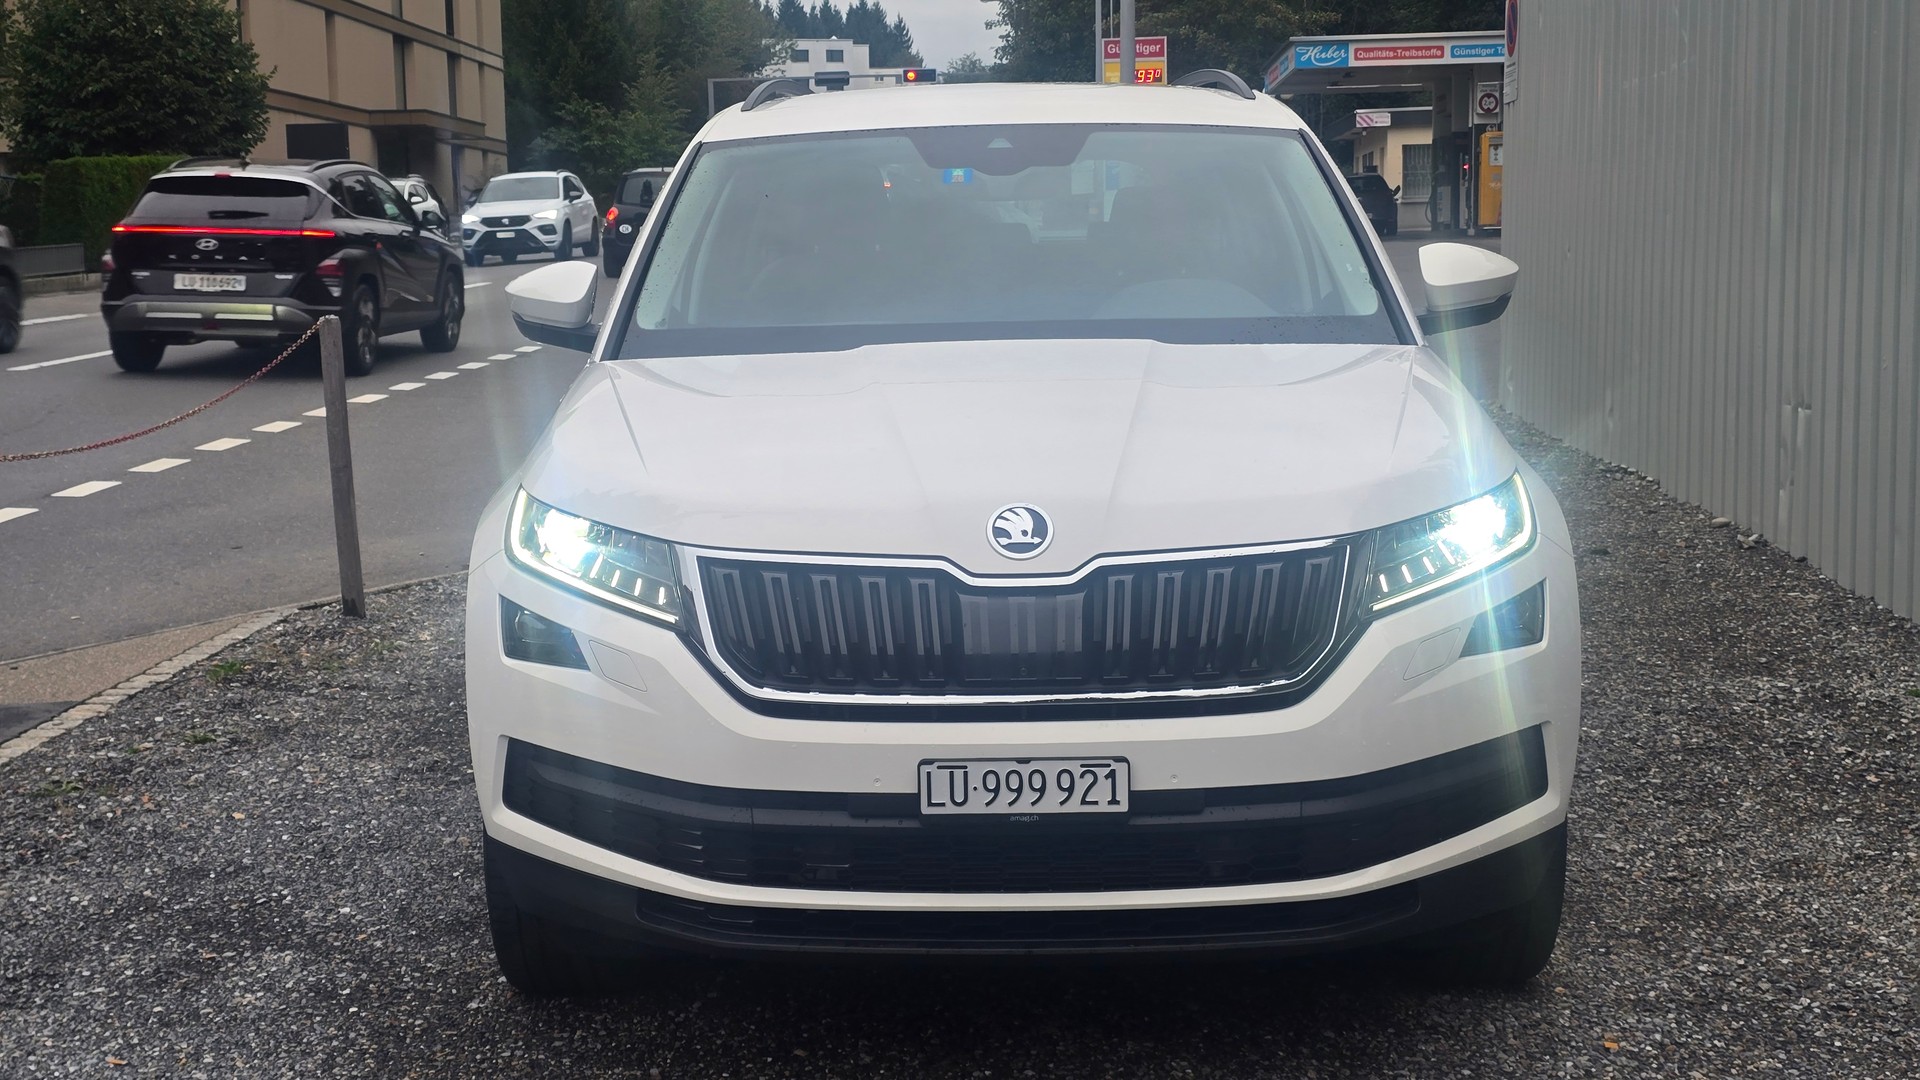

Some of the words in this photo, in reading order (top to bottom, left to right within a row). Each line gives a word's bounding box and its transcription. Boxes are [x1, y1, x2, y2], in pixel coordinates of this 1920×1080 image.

[1296, 45, 1347, 66] Huber
[1356, 48, 1442, 58] Qualitäts-Treibstoffe
[1453, 47, 1495, 57] Günstiger
[1009, 814, 1040, 822] amag.ch
